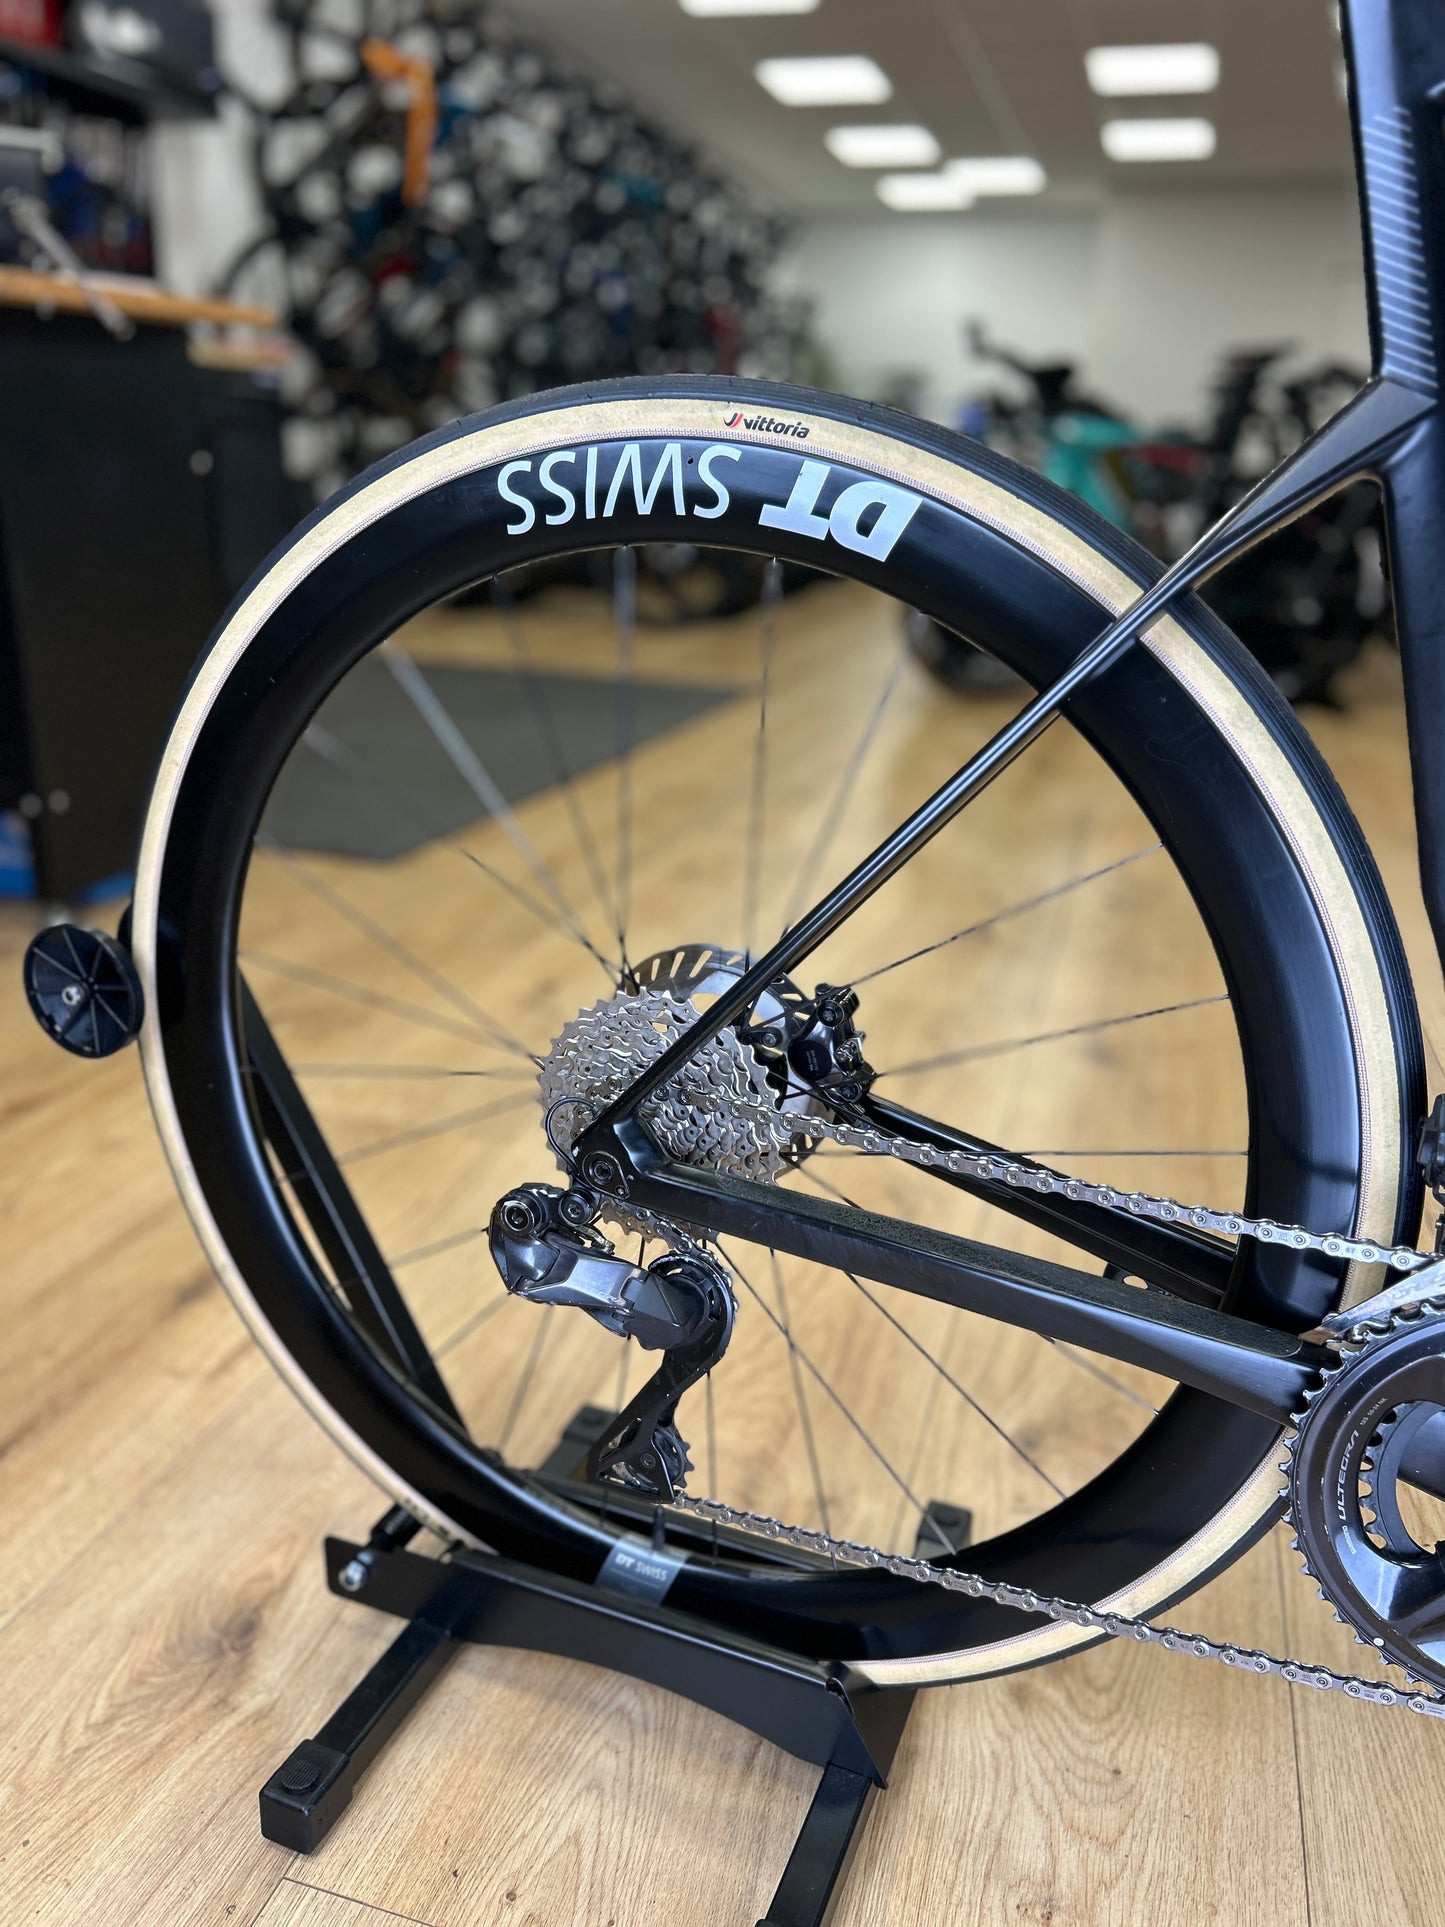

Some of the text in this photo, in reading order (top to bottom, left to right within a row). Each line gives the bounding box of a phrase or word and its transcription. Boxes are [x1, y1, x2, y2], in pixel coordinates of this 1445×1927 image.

[743, 415, 810, 439] vittoria
[498, 443, 925, 563] DT SWISS
[1337, 1429, 1360, 1521] ULTEGRA
[615, 1552, 668, 1582] DT SWISS
